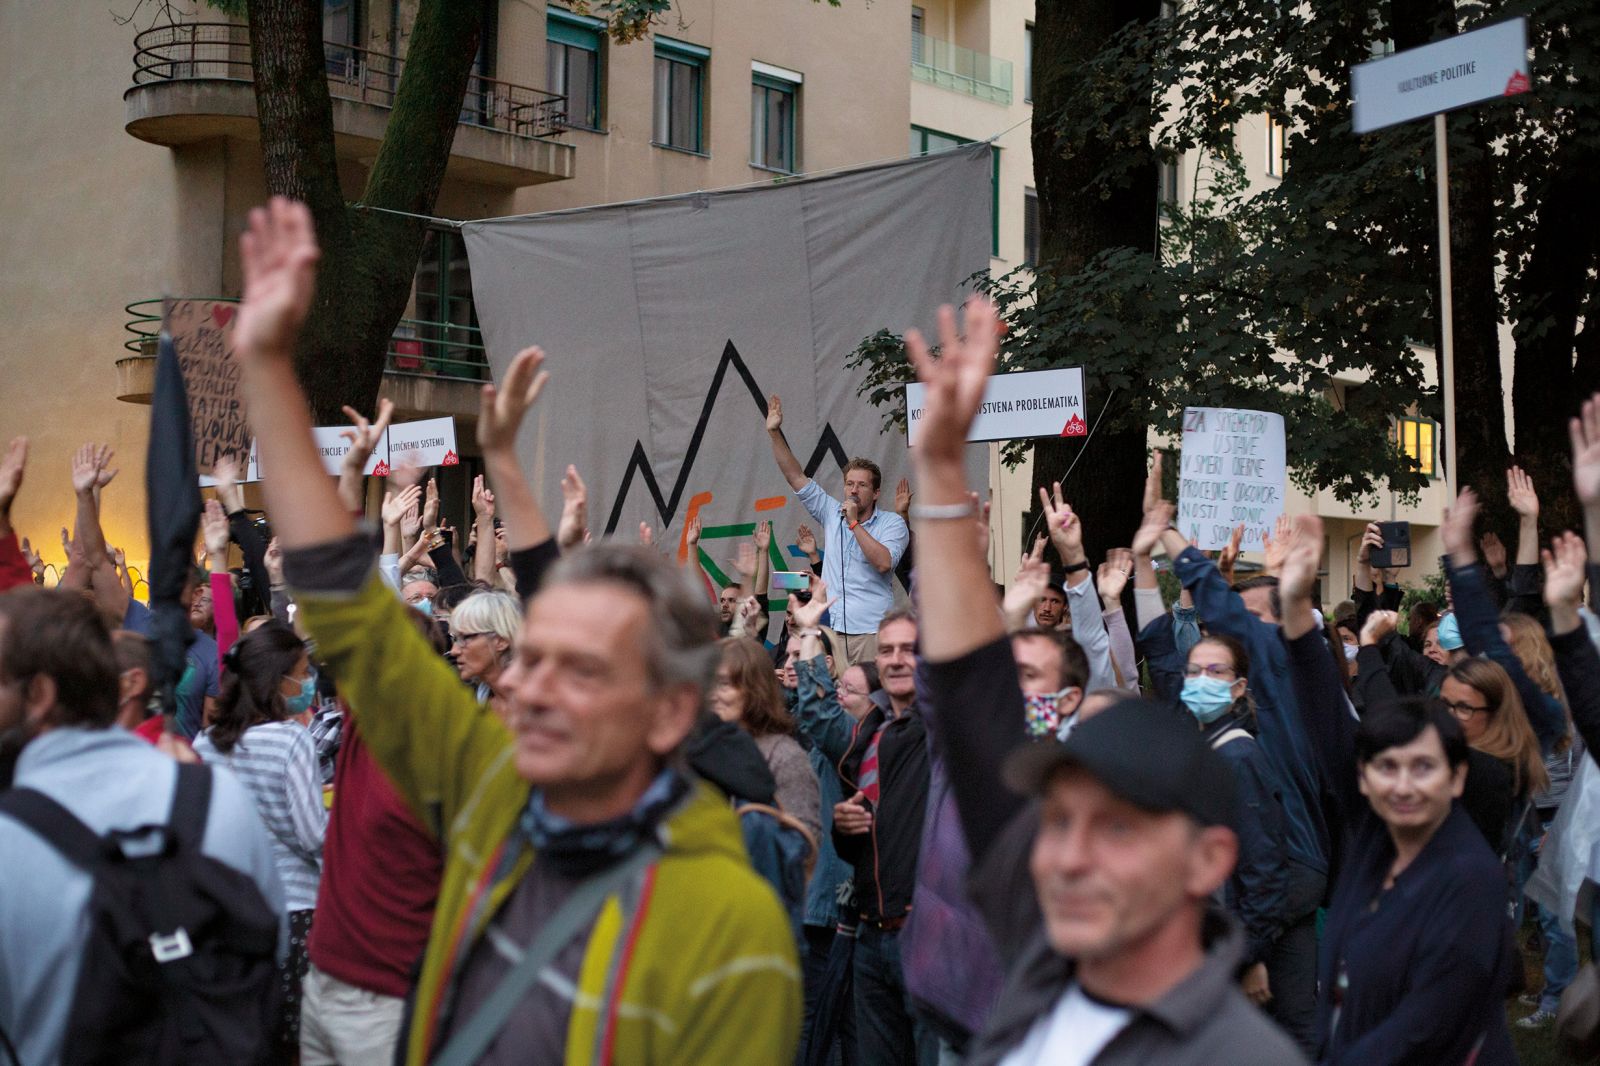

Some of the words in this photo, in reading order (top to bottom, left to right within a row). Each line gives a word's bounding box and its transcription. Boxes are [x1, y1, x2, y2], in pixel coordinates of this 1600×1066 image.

[1441, 60, 1477, 82] POLITIKE
[975, 400, 1013, 416] VSTVENA
[1016, 395, 1079, 412] PROBLEMATIKA
[1183, 411, 1206, 432] ZA
[389, 440, 420, 453] LITIČNEMU
[420, 437, 445, 449] SISTEMU
